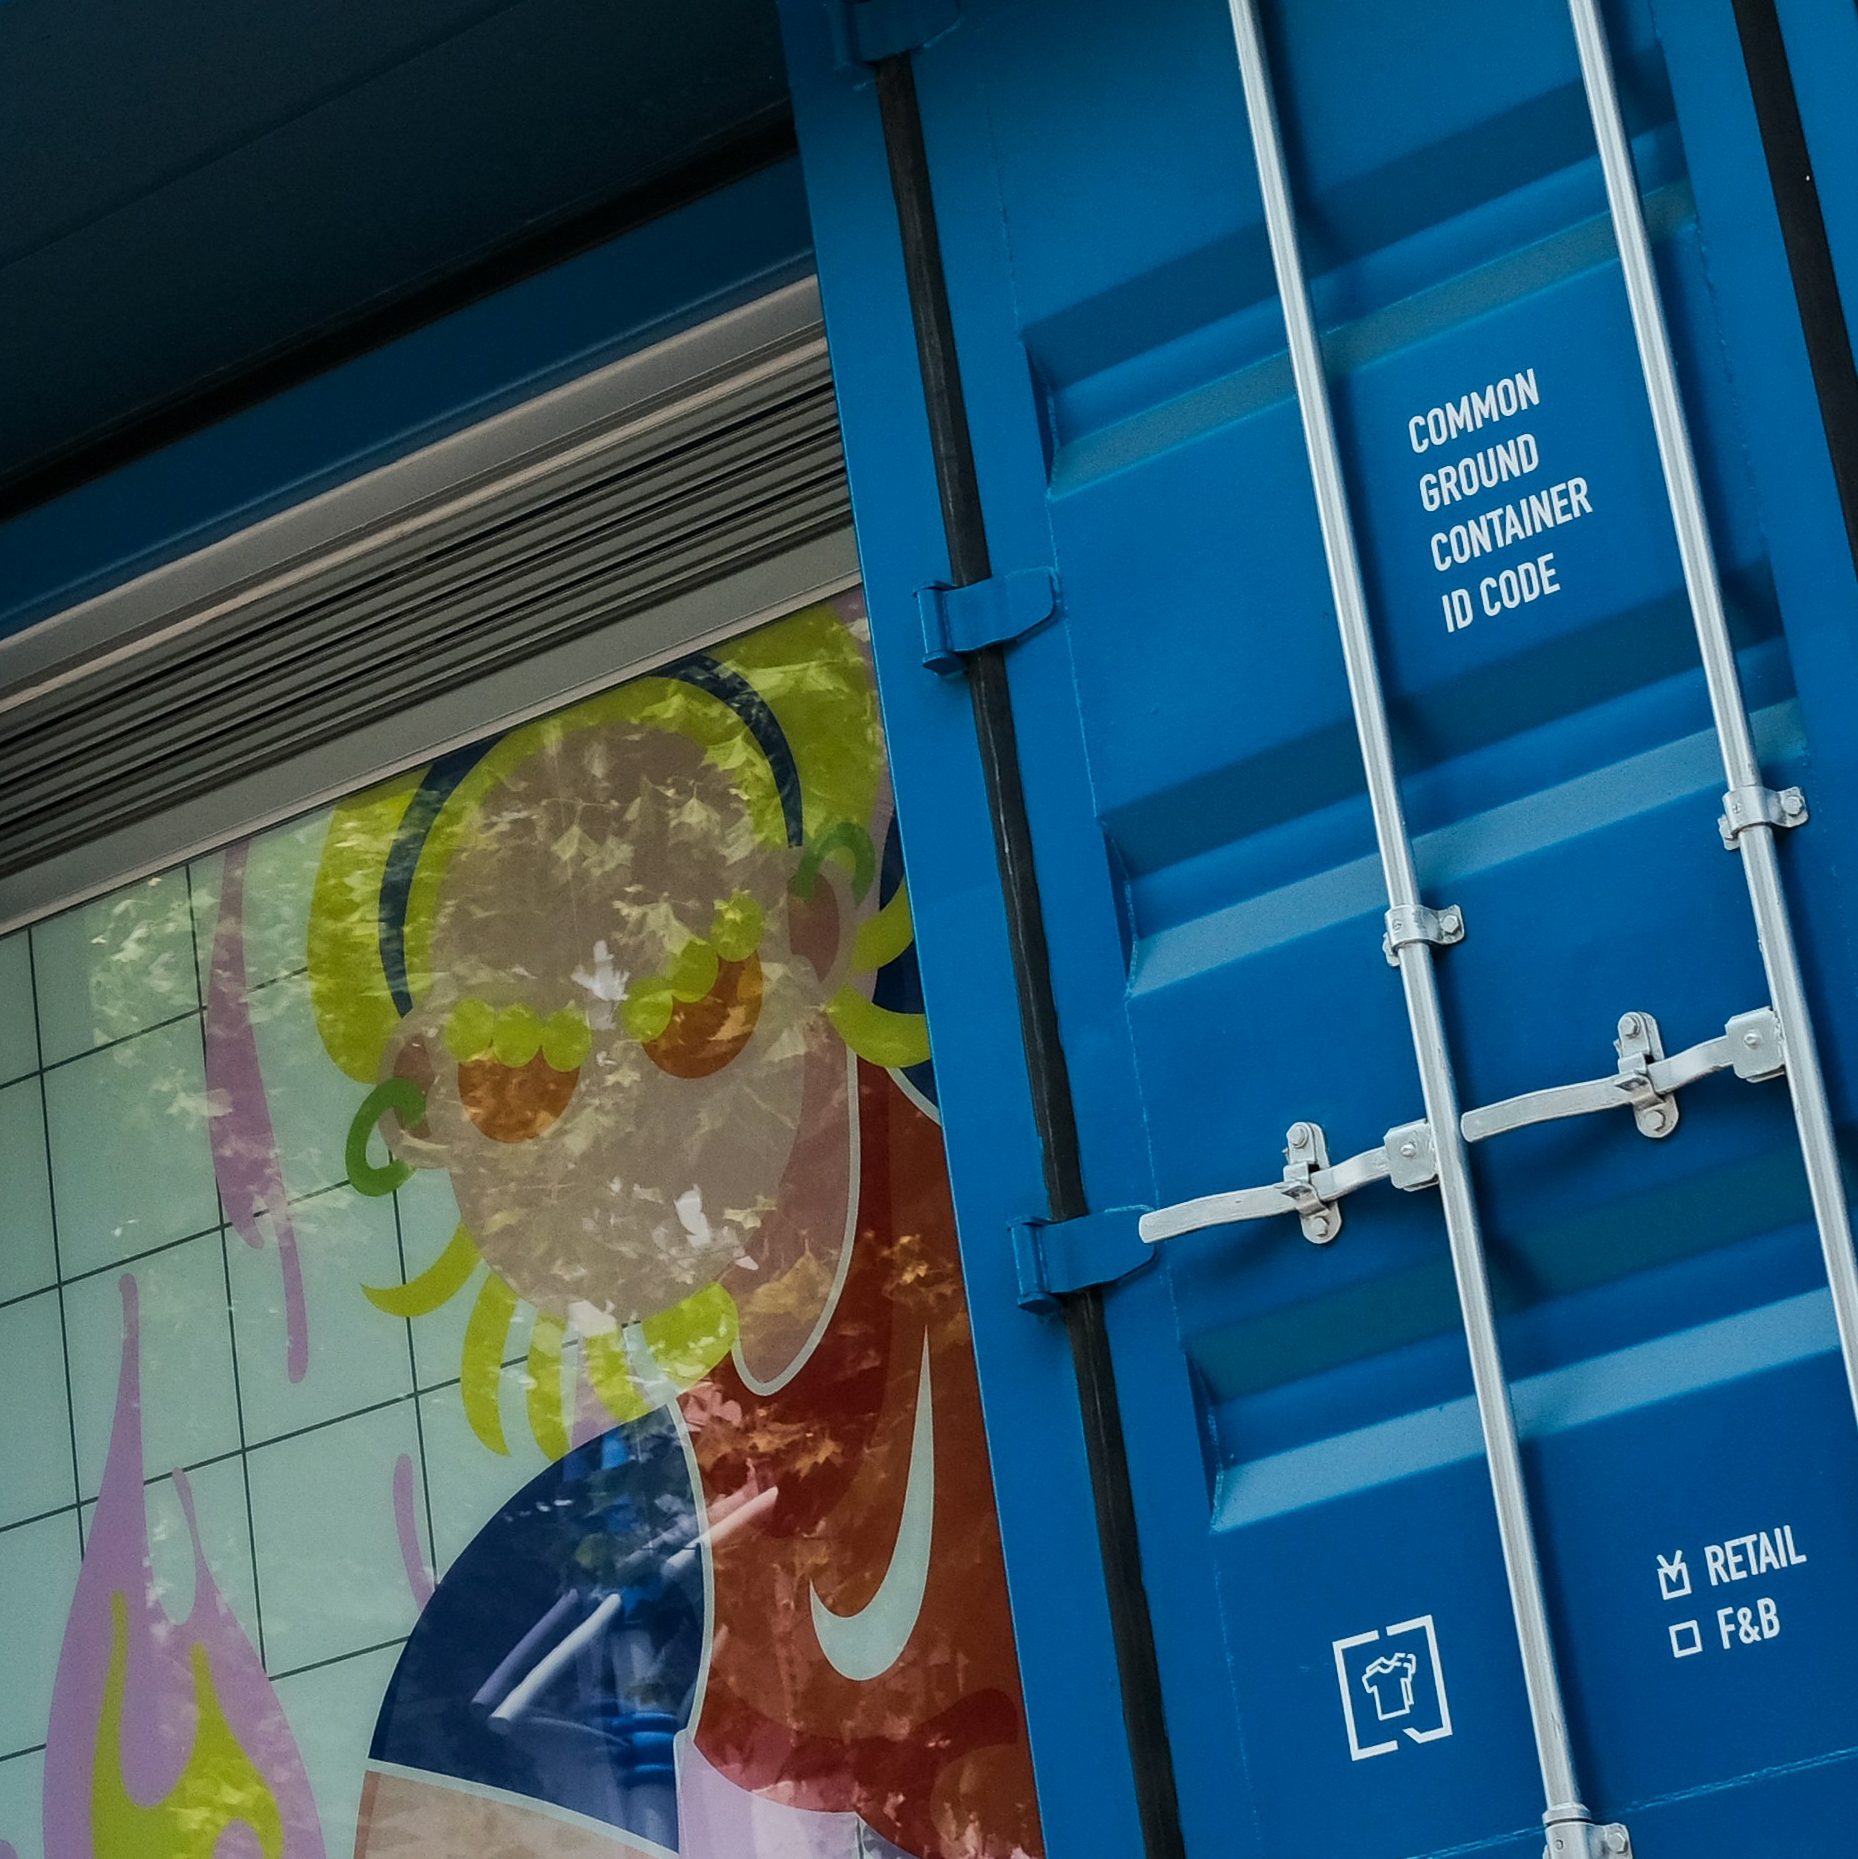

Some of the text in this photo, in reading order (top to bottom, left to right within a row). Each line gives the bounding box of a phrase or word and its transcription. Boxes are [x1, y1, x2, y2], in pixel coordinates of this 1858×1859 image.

[1408, 367, 1541, 454] COMMON
[1419, 432, 1540, 512] GROUND
[1430, 476, 1593, 572] CONTAINER
[1441, 552, 1561, 634] ID CODE
[1703, 1524, 1808, 1587] RETAIL
[1716, 1596, 1781, 1650] F&B
